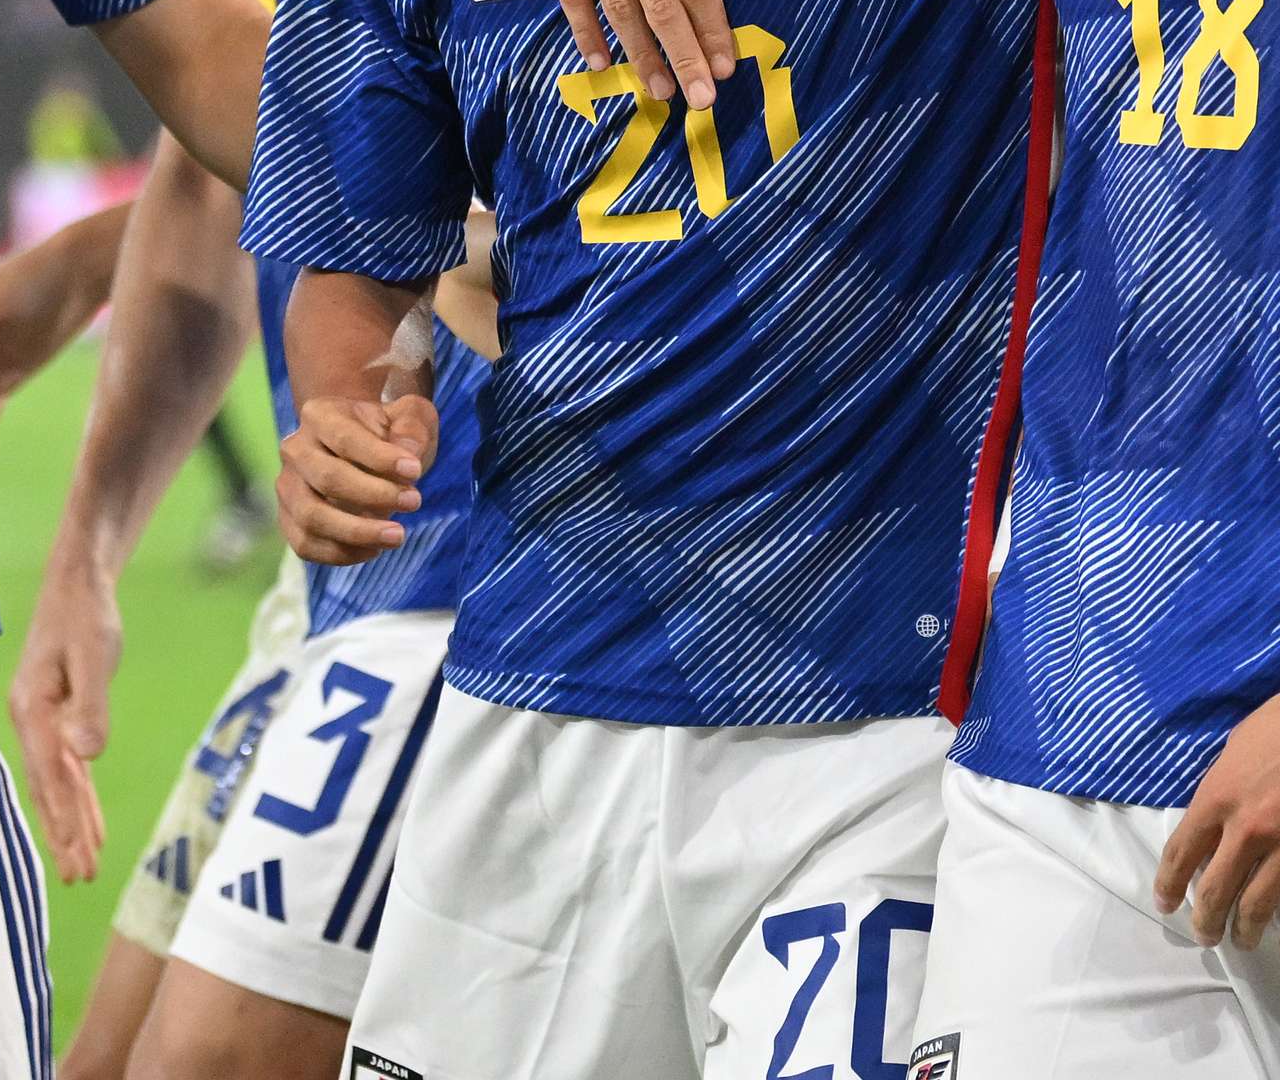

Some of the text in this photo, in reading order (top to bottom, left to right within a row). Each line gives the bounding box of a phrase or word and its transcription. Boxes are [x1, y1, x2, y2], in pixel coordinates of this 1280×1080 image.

[557, 24, 801, 244] 20
[253, 661, 394, 838] 3
[370, 1055, 409, 1080] JAPAN
[913, 1040, 943, 1063] JAPAN
